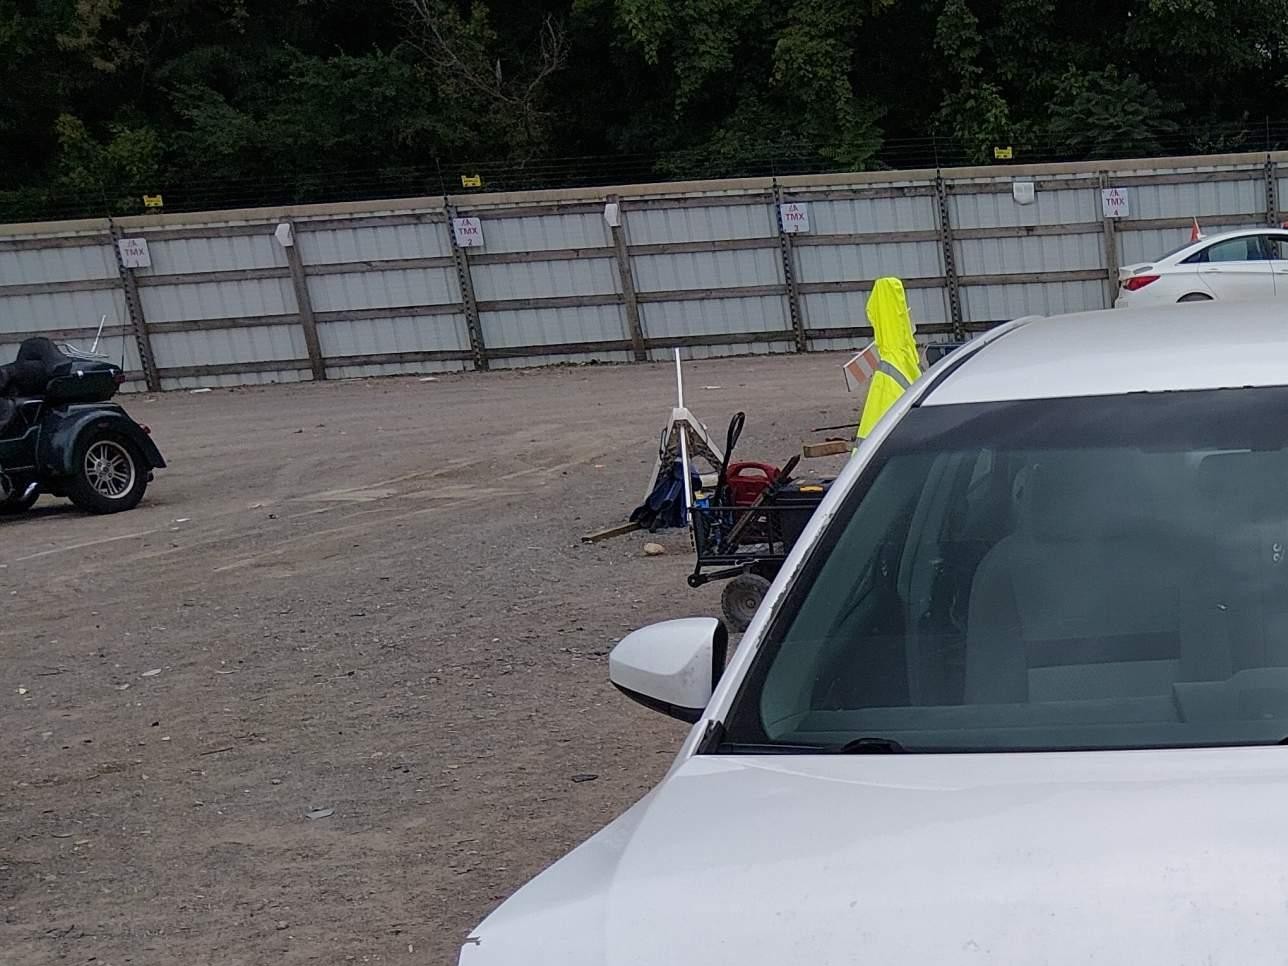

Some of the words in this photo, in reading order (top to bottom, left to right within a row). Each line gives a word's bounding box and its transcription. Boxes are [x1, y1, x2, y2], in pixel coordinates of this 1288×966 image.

[785, 213, 805, 221] TMX
[458, 227, 478, 235] TMX
[124, 248, 145, 256] TMX
